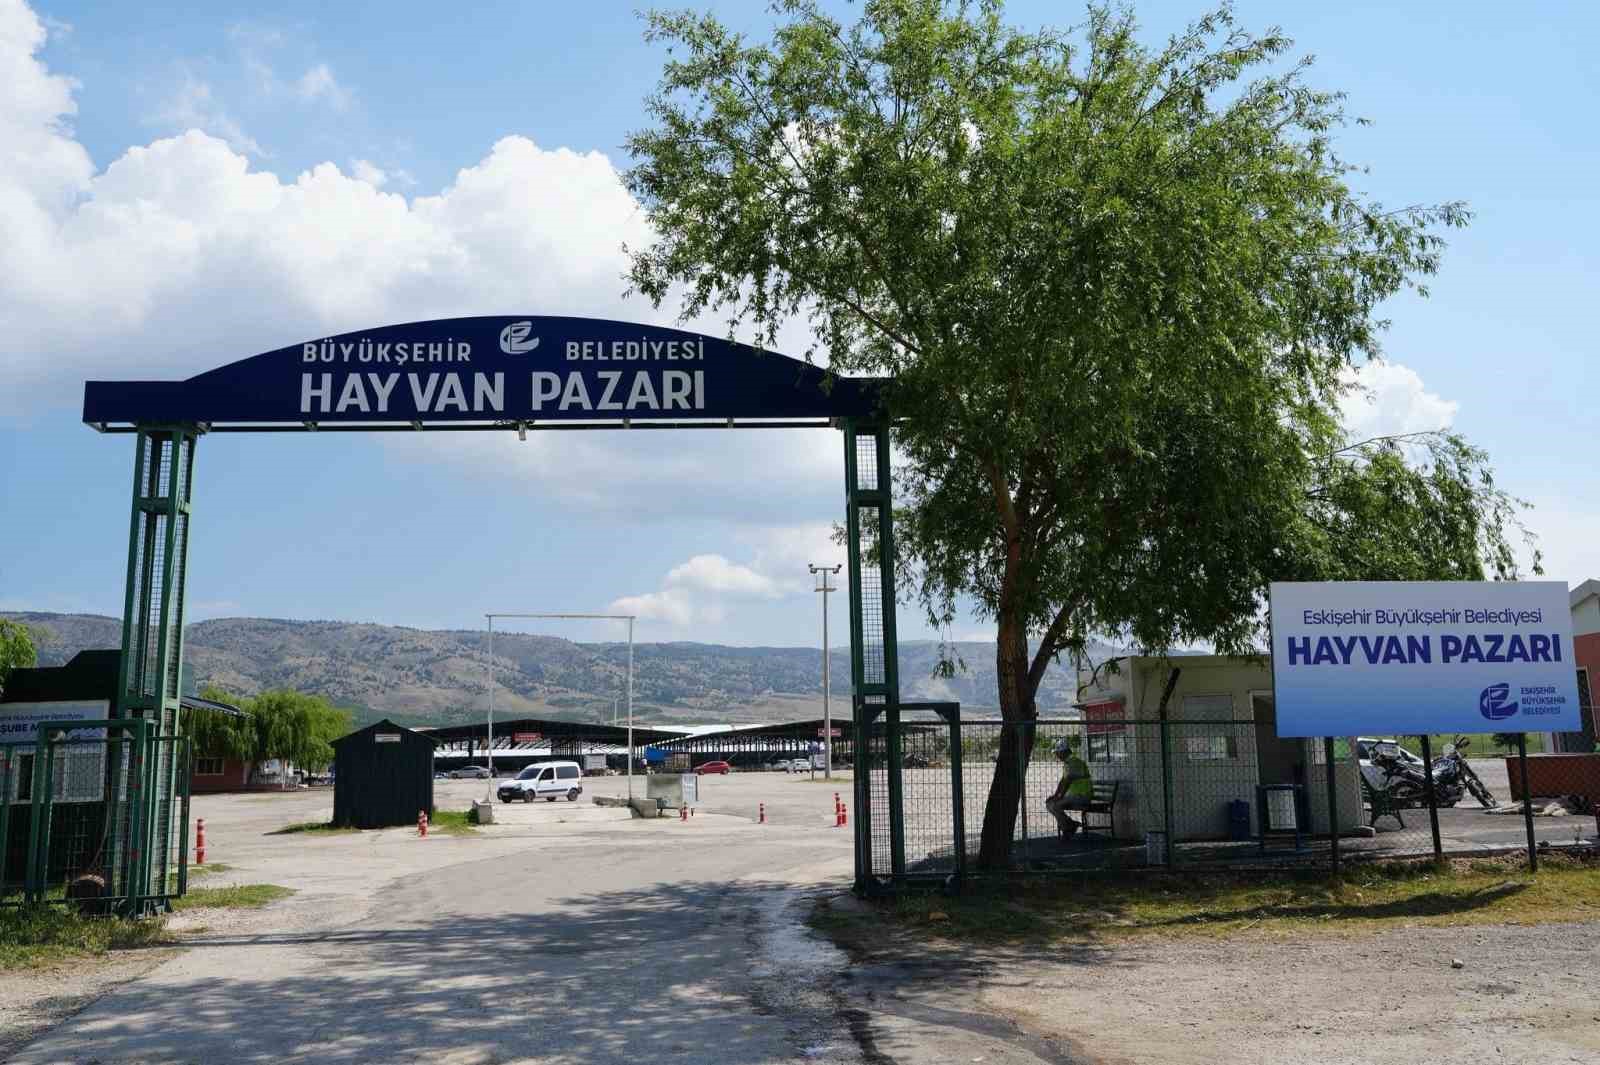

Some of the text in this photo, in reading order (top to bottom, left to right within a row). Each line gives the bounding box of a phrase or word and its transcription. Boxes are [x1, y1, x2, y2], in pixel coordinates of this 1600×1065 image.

[303, 336, 704, 365] BÜYÜKŞEHİR BELEDİYESİ
[300, 370, 705, 413] HAYVAN PAZARI
[1303, 608, 1543, 627] Eskişehir Büyükşehir Belediyesi
[1287, 633, 1562, 665] HAYVAN PAZARI
